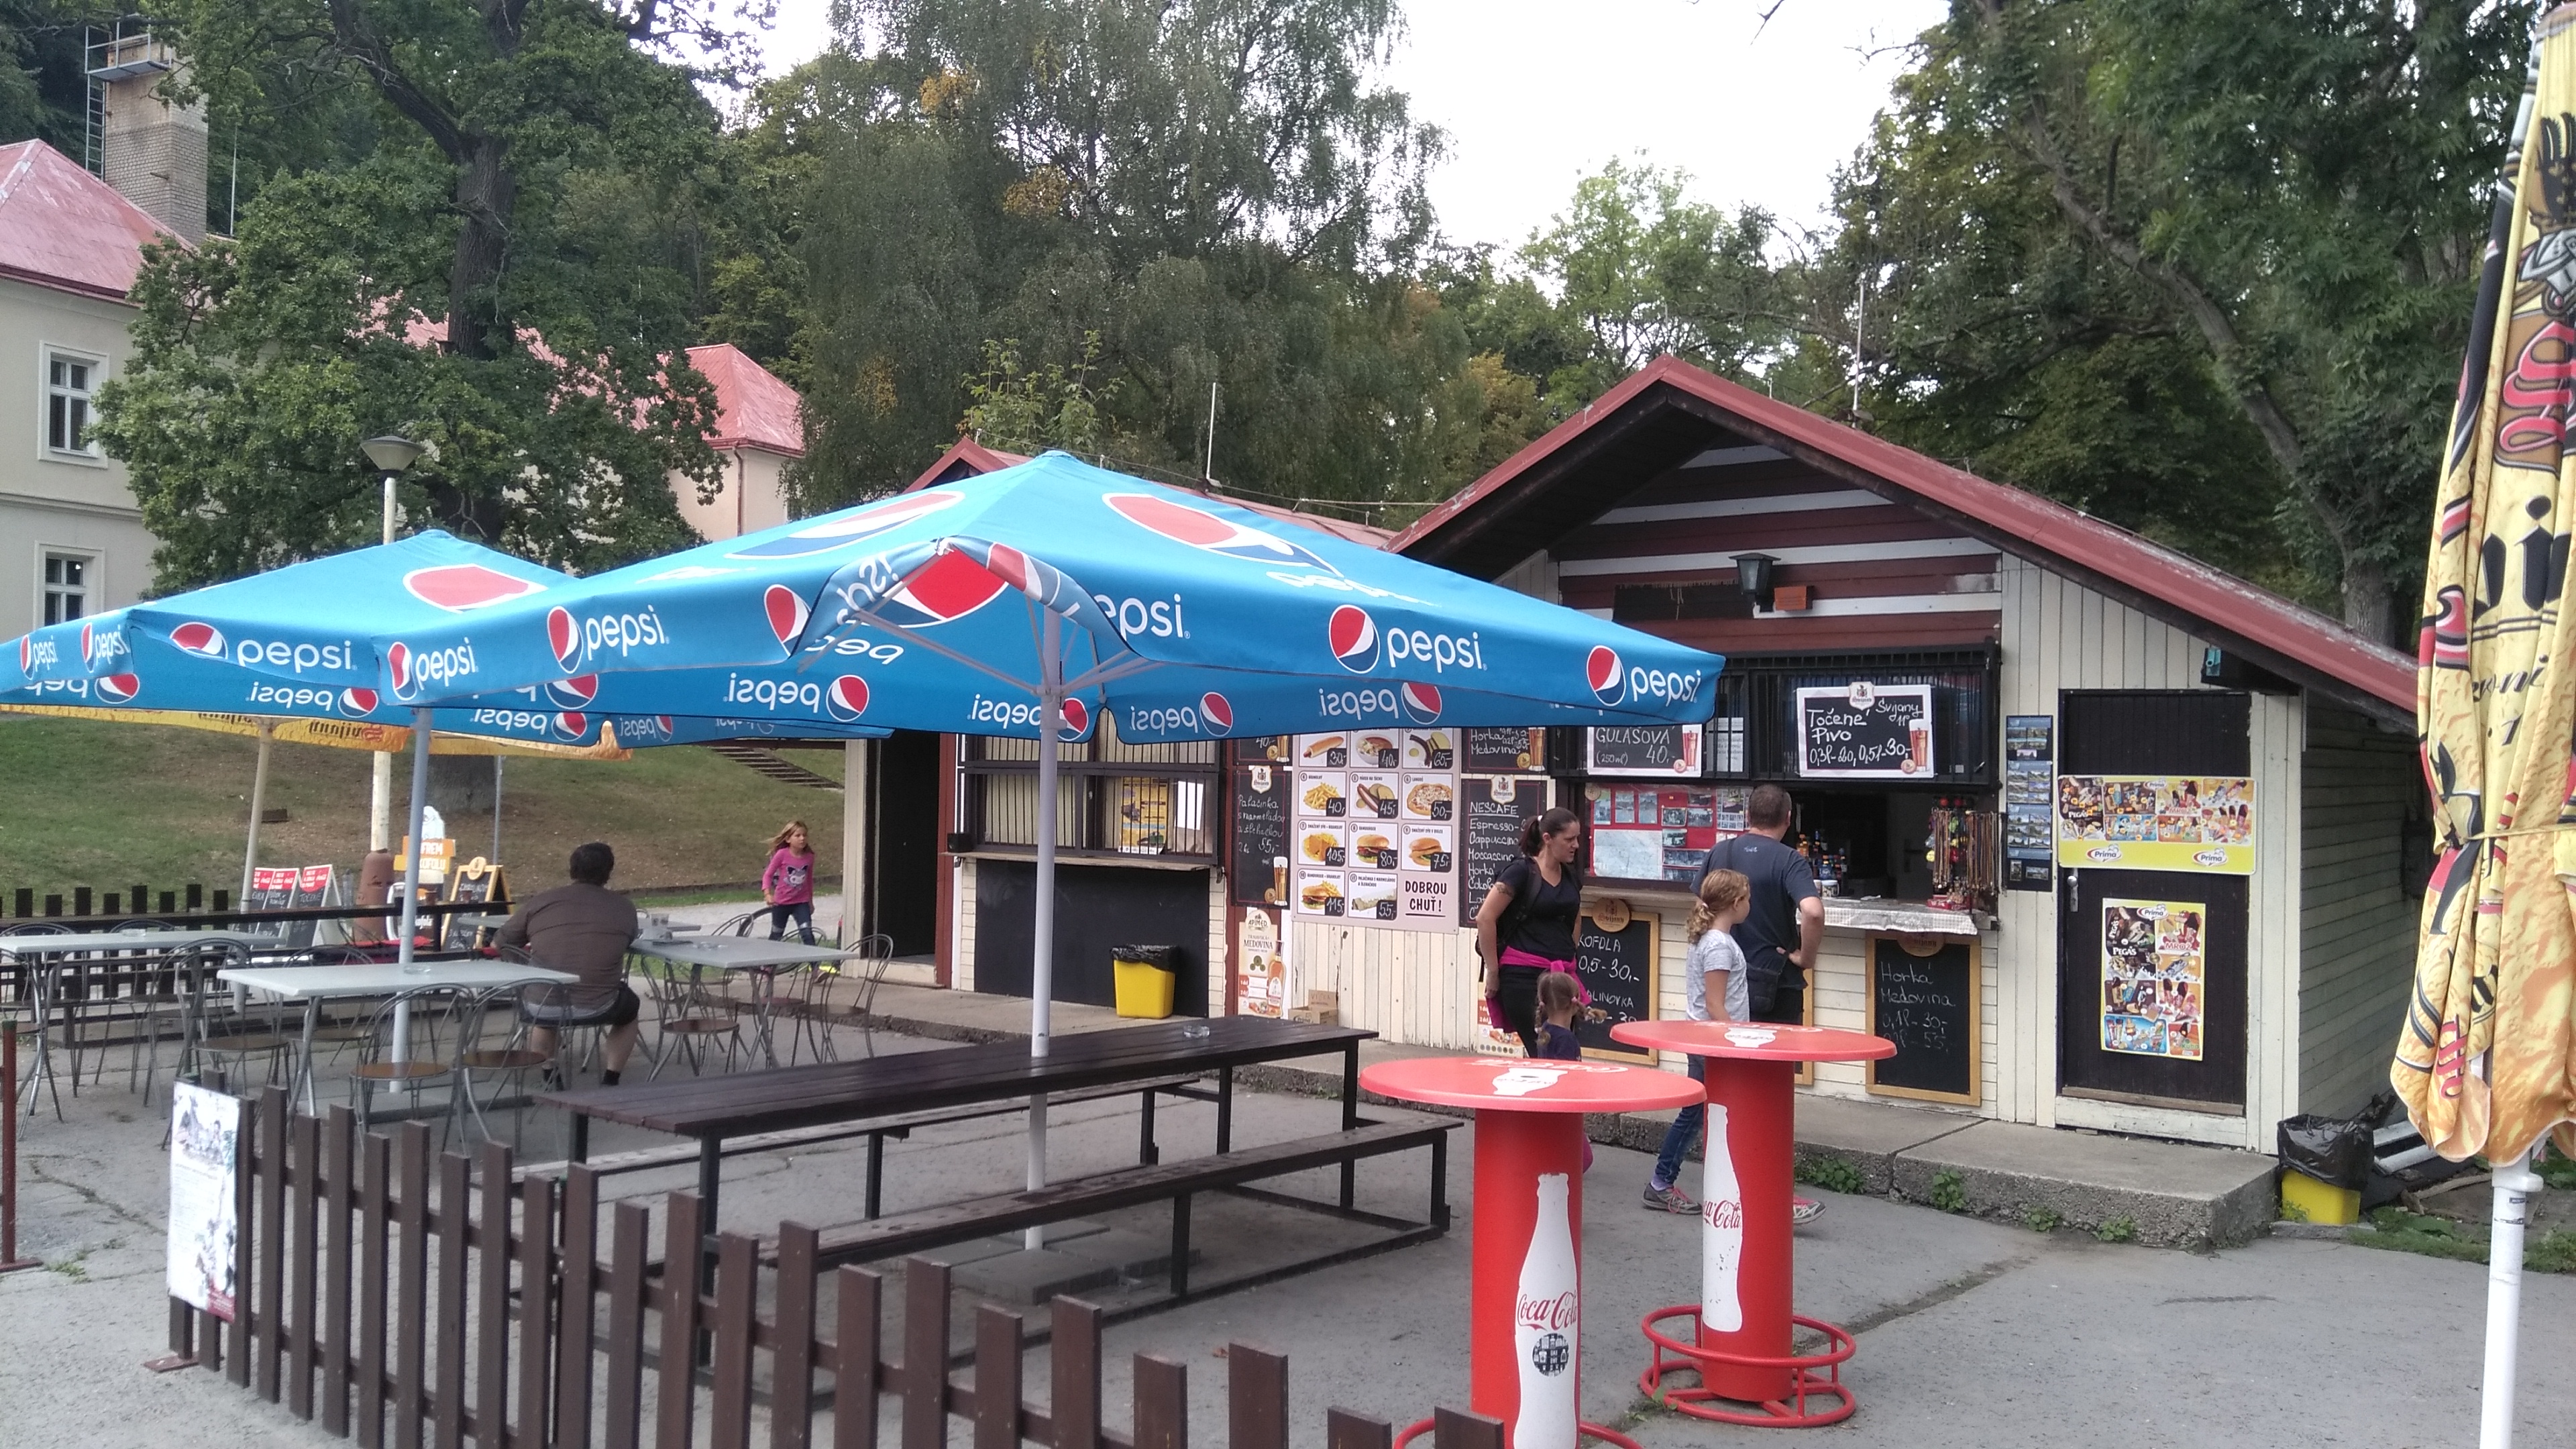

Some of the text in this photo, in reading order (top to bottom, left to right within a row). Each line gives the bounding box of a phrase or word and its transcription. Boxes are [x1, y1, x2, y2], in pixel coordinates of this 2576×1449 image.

[95, 625, 130, 665] pepsi
[586, 605, 665, 660] pepsi
[34, 635, 58, 672] pepsi
[237, 639, 352, 673] pepsi
[416, 637, 476, 690] pepsi
[1387, 627, 1482, 673] pepsi
[1631, 666, 1701, 706] pepsi
[1807, 708, 1870, 727] Točené
[1471, 743, 1521, 755] Medovina
[2094, 850, 2116, 859] Prima
[2200, 854, 2222, 863] Prima
[1405, 880, 1447, 895] DOBROU
[1244, 939, 1273, 950] MEDOVINA
